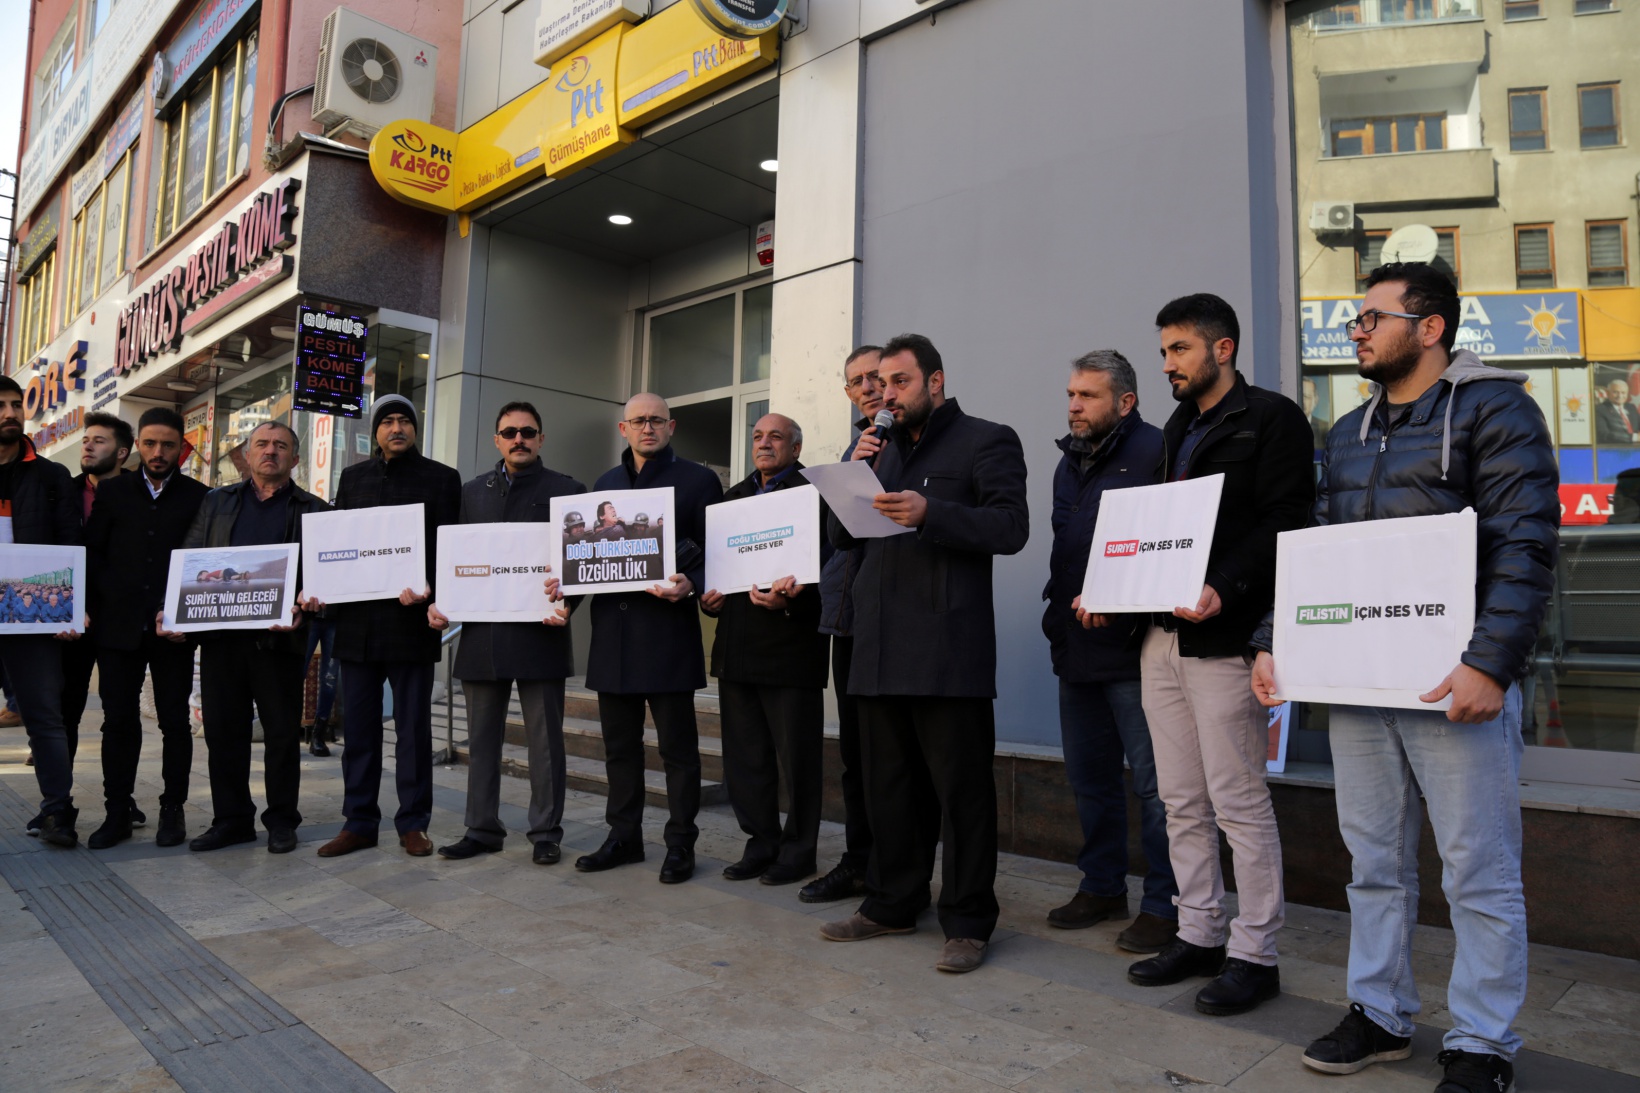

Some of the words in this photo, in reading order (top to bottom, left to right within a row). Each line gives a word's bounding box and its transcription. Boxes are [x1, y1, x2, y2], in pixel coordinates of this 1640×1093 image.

[538, 13, 571, 38] Ulaştırma
[539, 20, 579, 50] Haberleşme
[571, 78, 604, 128] Ptt
[430, 143, 453, 164] Ptt
[549, 123, 611, 165] Gümüşhane
[389, 149, 451, 182] KARGO
[114, 265, 186, 378] GÜMÜŞ
[303, 312, 365, 339] GÜMÜŞ
[304, 335, 361, 357] PESTİL
[307, 356, 356, 375] KÖME
[307, 375, 354, 393] BALLI
[566, 540, 593, 560] DOĞU
[594, 537, 659, 558] TÜRKİSTAN'A
[729, 536, 750, 546] DOĞU
[754, 543, 768, 551] SES
[768, 540, 784, 548] VER
[1157, 539, 1173, 551] SES
[1175, 538, 1193, 549] VER
[320, 551, 357, 561] ARAKAN
[377, 548, 393, 556] SES
[394, 546, 411, 554] VER
[457, 567, 489, 575] YEMEN
[512, 566, 529, 574] SES
[578, 557, 647, 583] ÖZGÜRLÜK!
[185, 590, 235, 606] SURİYE'NİN
[237, 588, 279, 603] GELECEĞİ
[187, 605, 218, 619] KIYIYA
[218, 603, 272, 618] VURMASIN!
[1384, 605, 1411, 618] SES
[1414, 603, 1446, 617] VER
